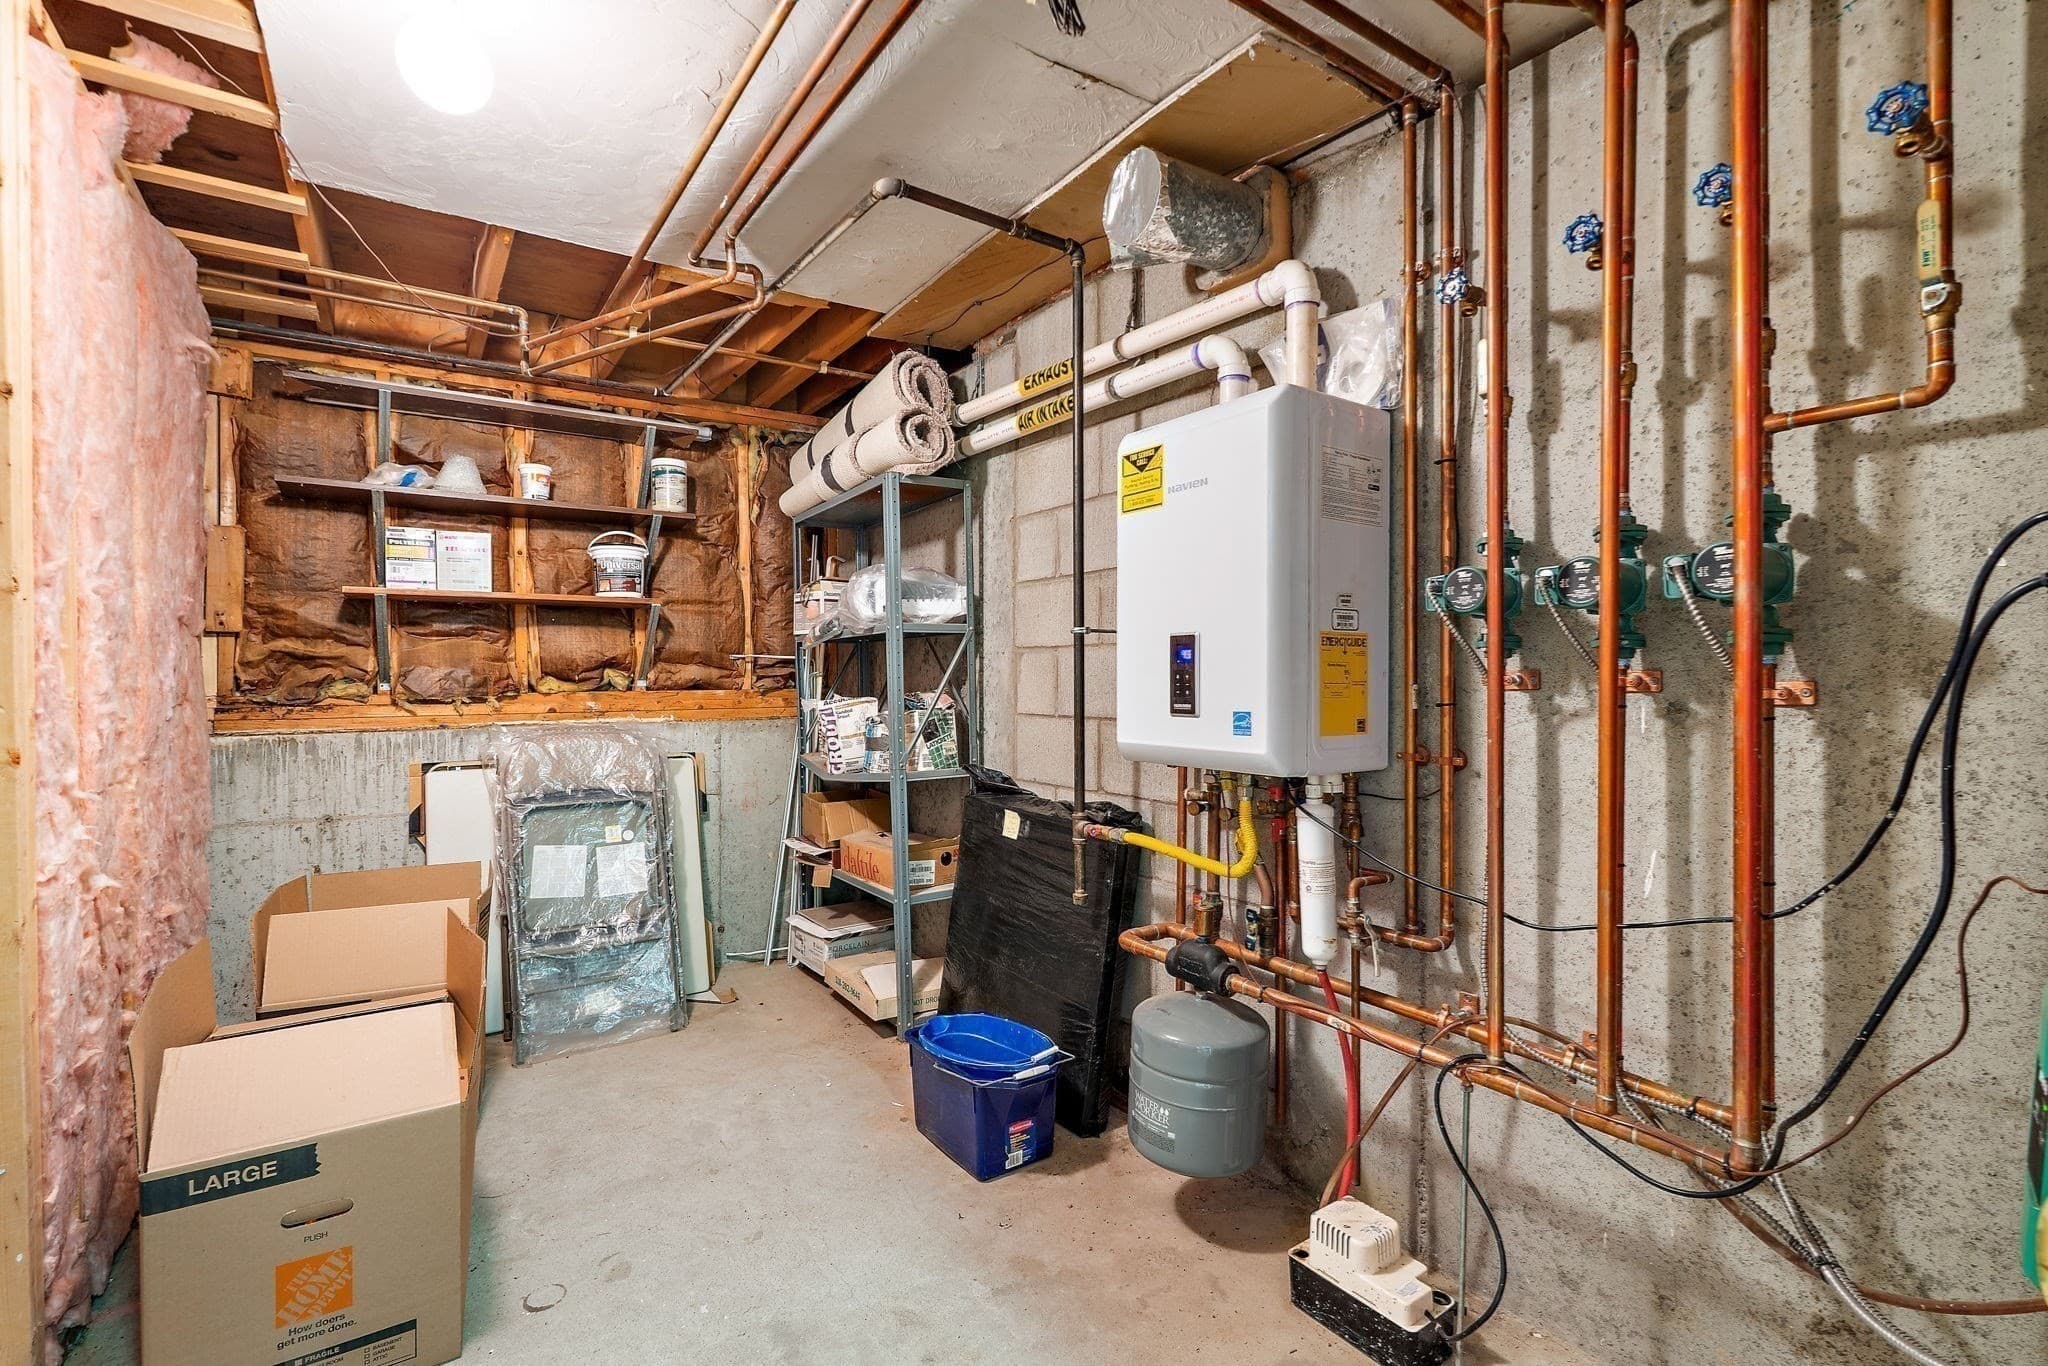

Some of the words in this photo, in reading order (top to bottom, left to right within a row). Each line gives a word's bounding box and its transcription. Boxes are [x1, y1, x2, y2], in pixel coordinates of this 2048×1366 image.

[1017, 411, 1035, 432] AIR
[1036, 394, 1074, 424] INTAKE
[600, 559, 641, 570] Universal
[843, 845, 880, 884] daltile
[828, 939, 870, 953] PORCELAIN
[1135, 1089, 1158, 1111] WATER
[1136, 1100, 1170, 1126] WORKER
[188, 1160, 278, 1196] LARGE
[303, 1231, 329, 1243] PUSH
[275, 1248, 353, 1322] HOME
[281, 1262, 313, 1294] THE
[305, 1267, 353, 1318] DEPOT
[276, 1339, 296, 1351] get
[297, 1328, 326, 1343] more
[328, 1319, 358, 1334] done.
[288, 1323, 313, 1337] How
[315, 1312, 346, 1328] doers
[304, 1346, 340, 1363] FRAGILE
[373, 1337, 403, 1351] BASEMENT
